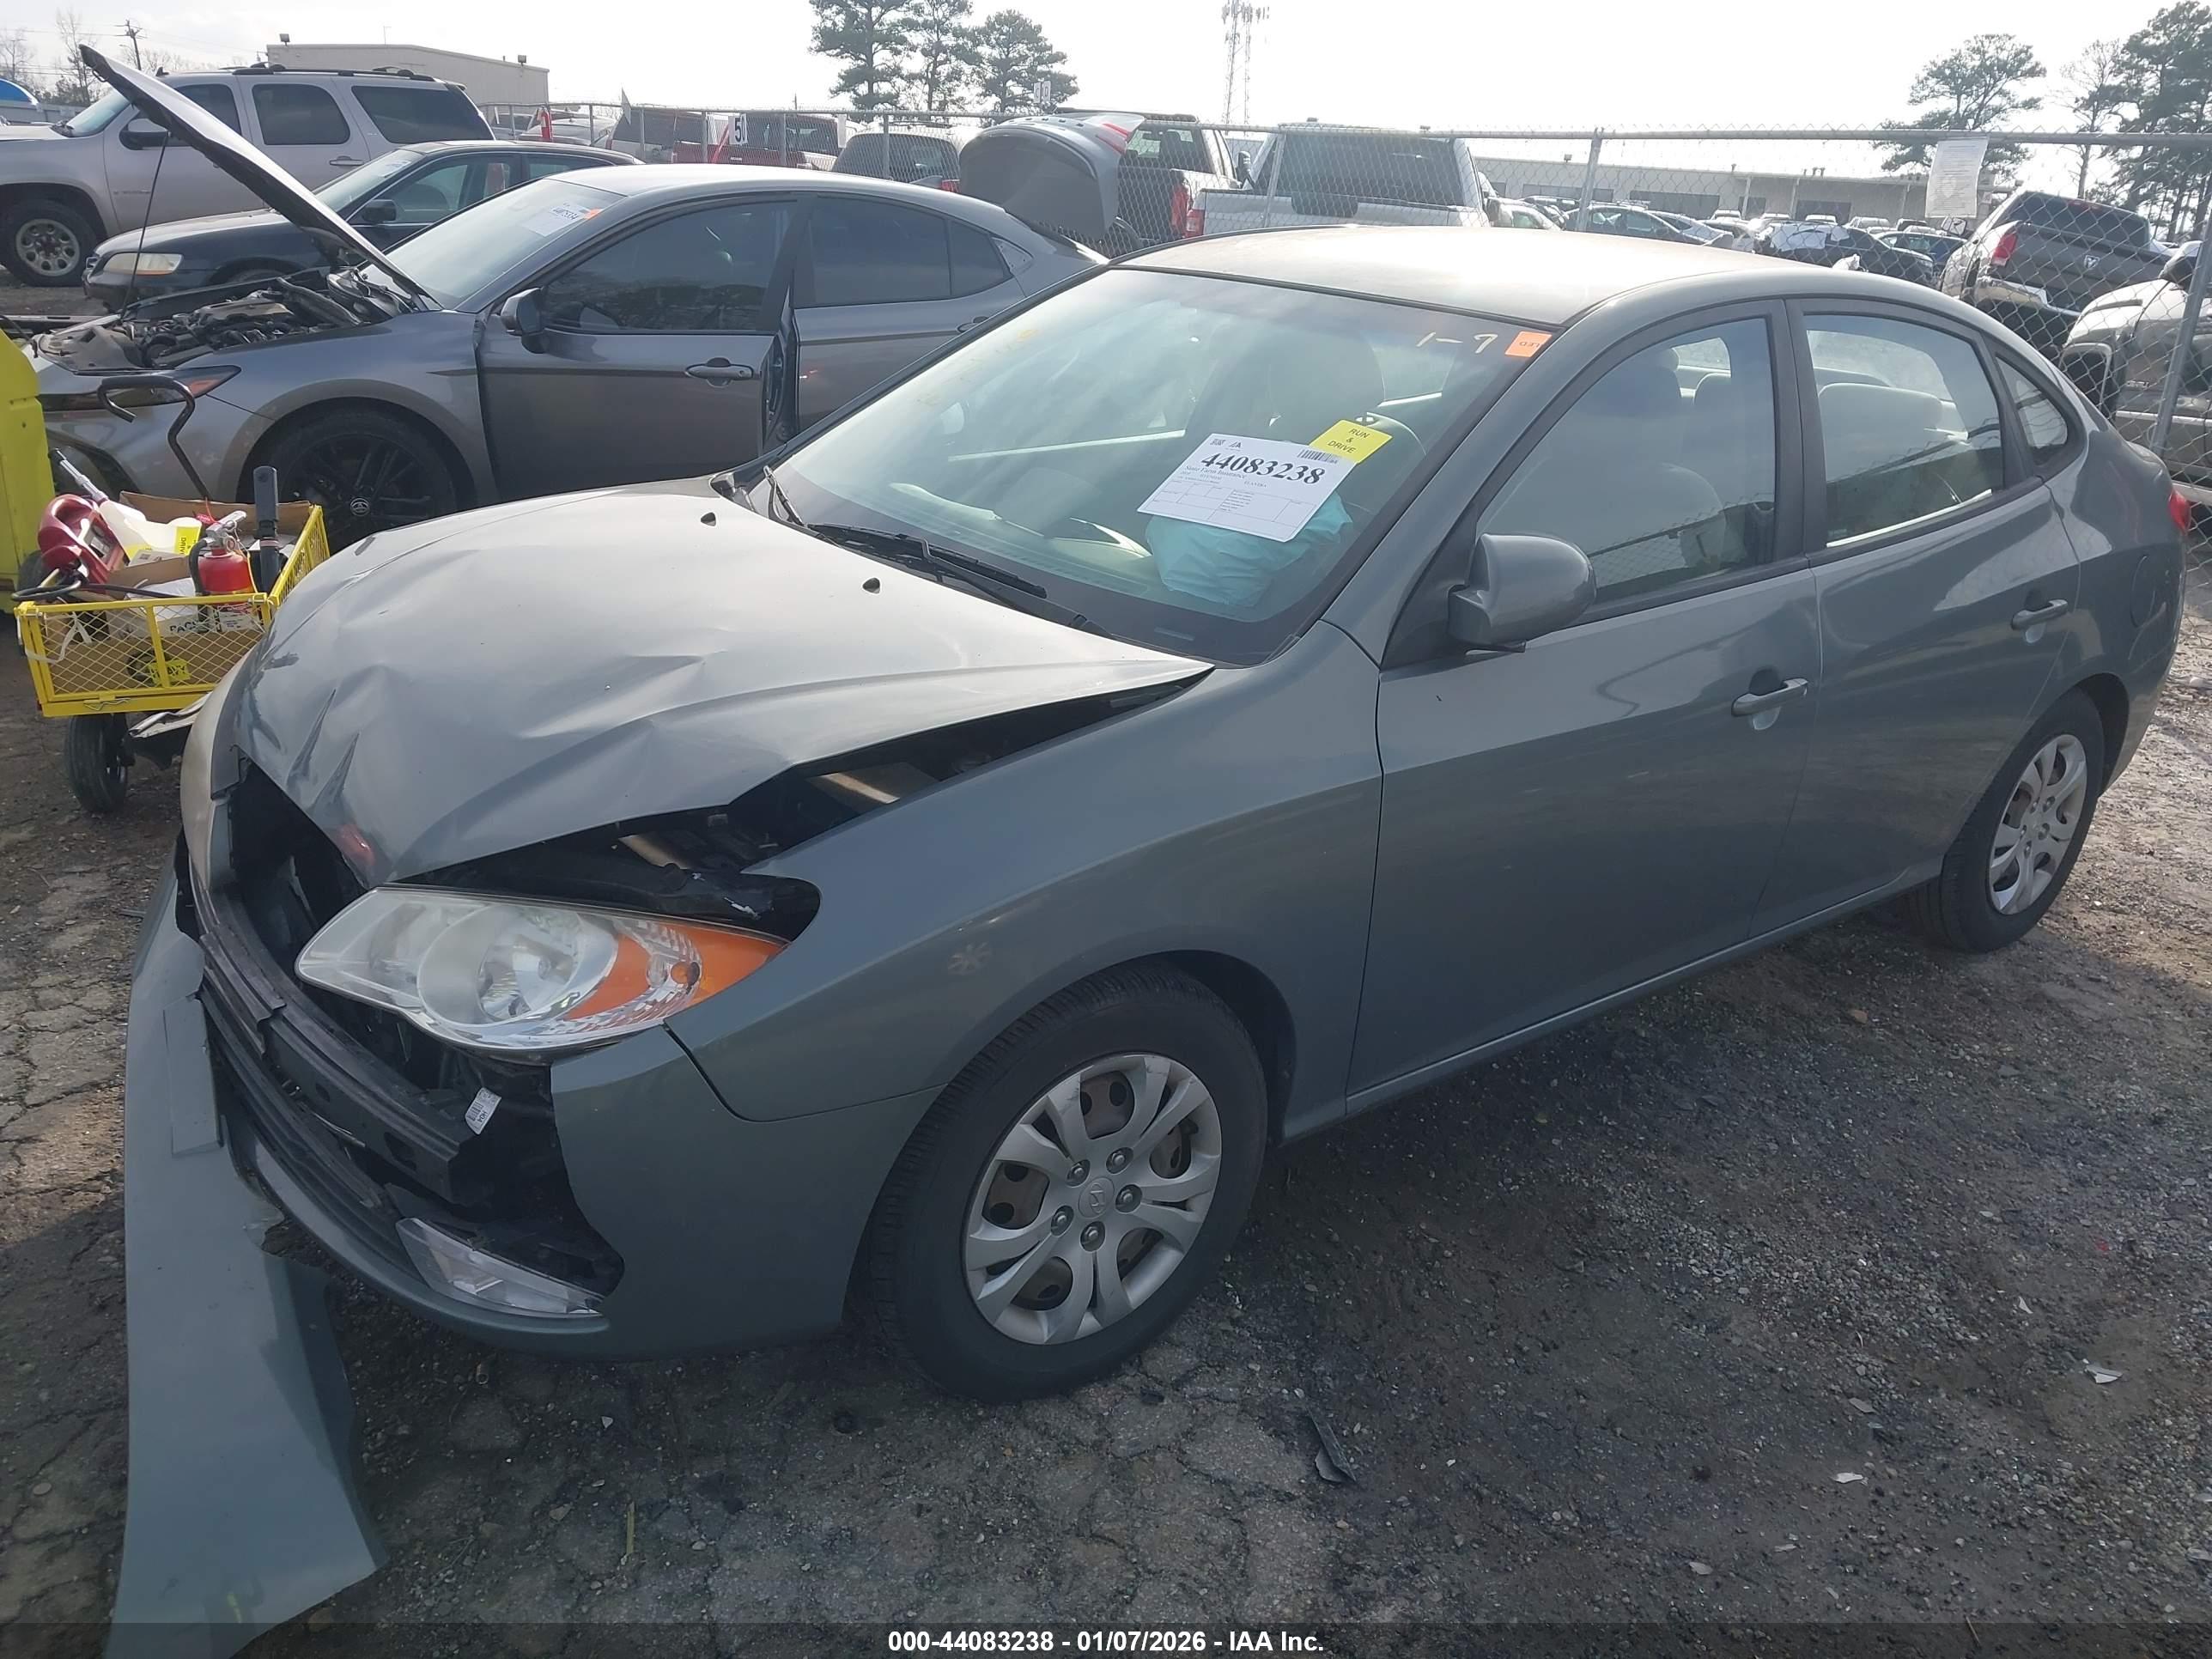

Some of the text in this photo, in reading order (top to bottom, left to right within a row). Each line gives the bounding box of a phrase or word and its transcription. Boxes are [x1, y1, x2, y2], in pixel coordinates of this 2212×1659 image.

[1348, 428, 1370, 439] RUN
[1327, 440, 1357, 453] DRIVE
[1200, 453, 1326, 484] 44083238
